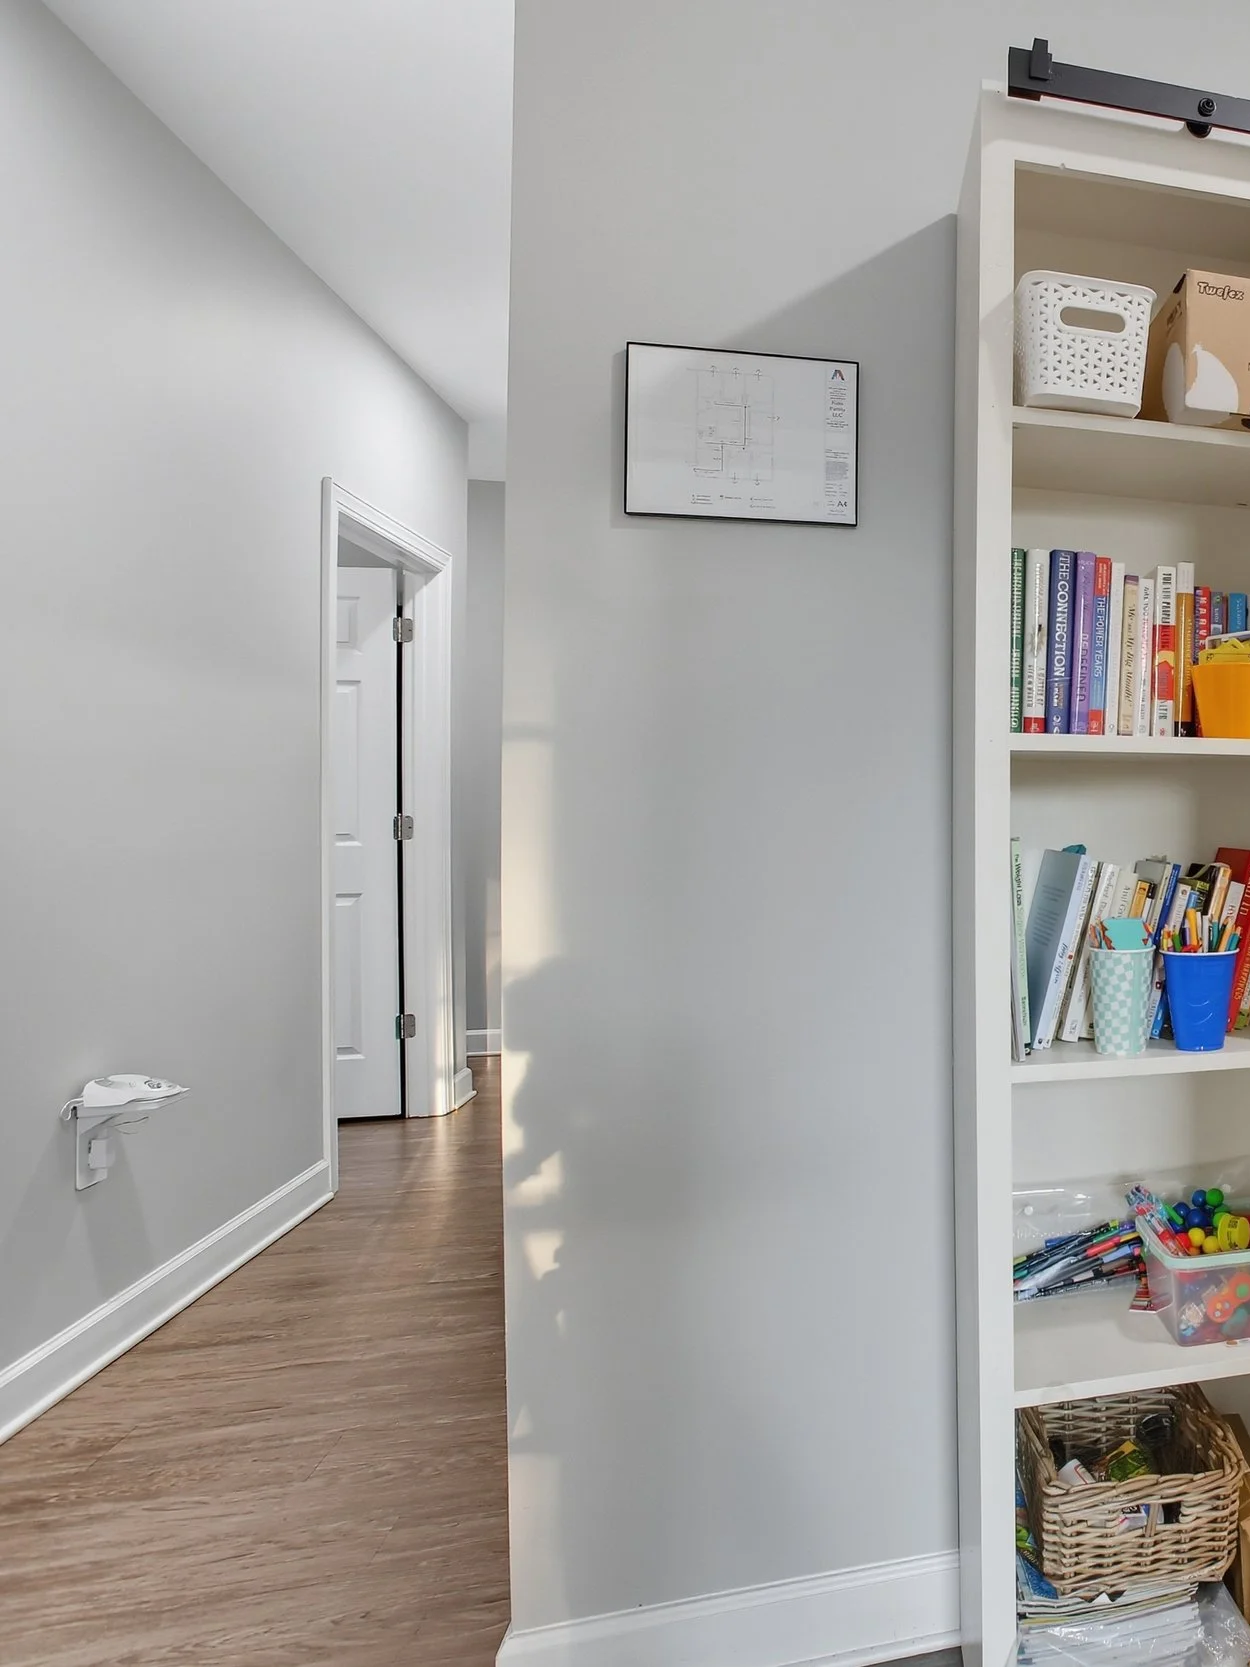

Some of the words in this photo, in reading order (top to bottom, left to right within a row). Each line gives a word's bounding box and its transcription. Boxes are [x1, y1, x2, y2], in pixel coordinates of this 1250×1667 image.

[1058, 553, 1071, 580] THE
[1096, 596, 1106, 613] THE
[1053, 581, 1069, 677] CONNECTION
[1095, 615, 1106, 647] POWER
[1198, 596, 1207, 648] MARVE
[1093, 650, 1104, 677] YEARS
